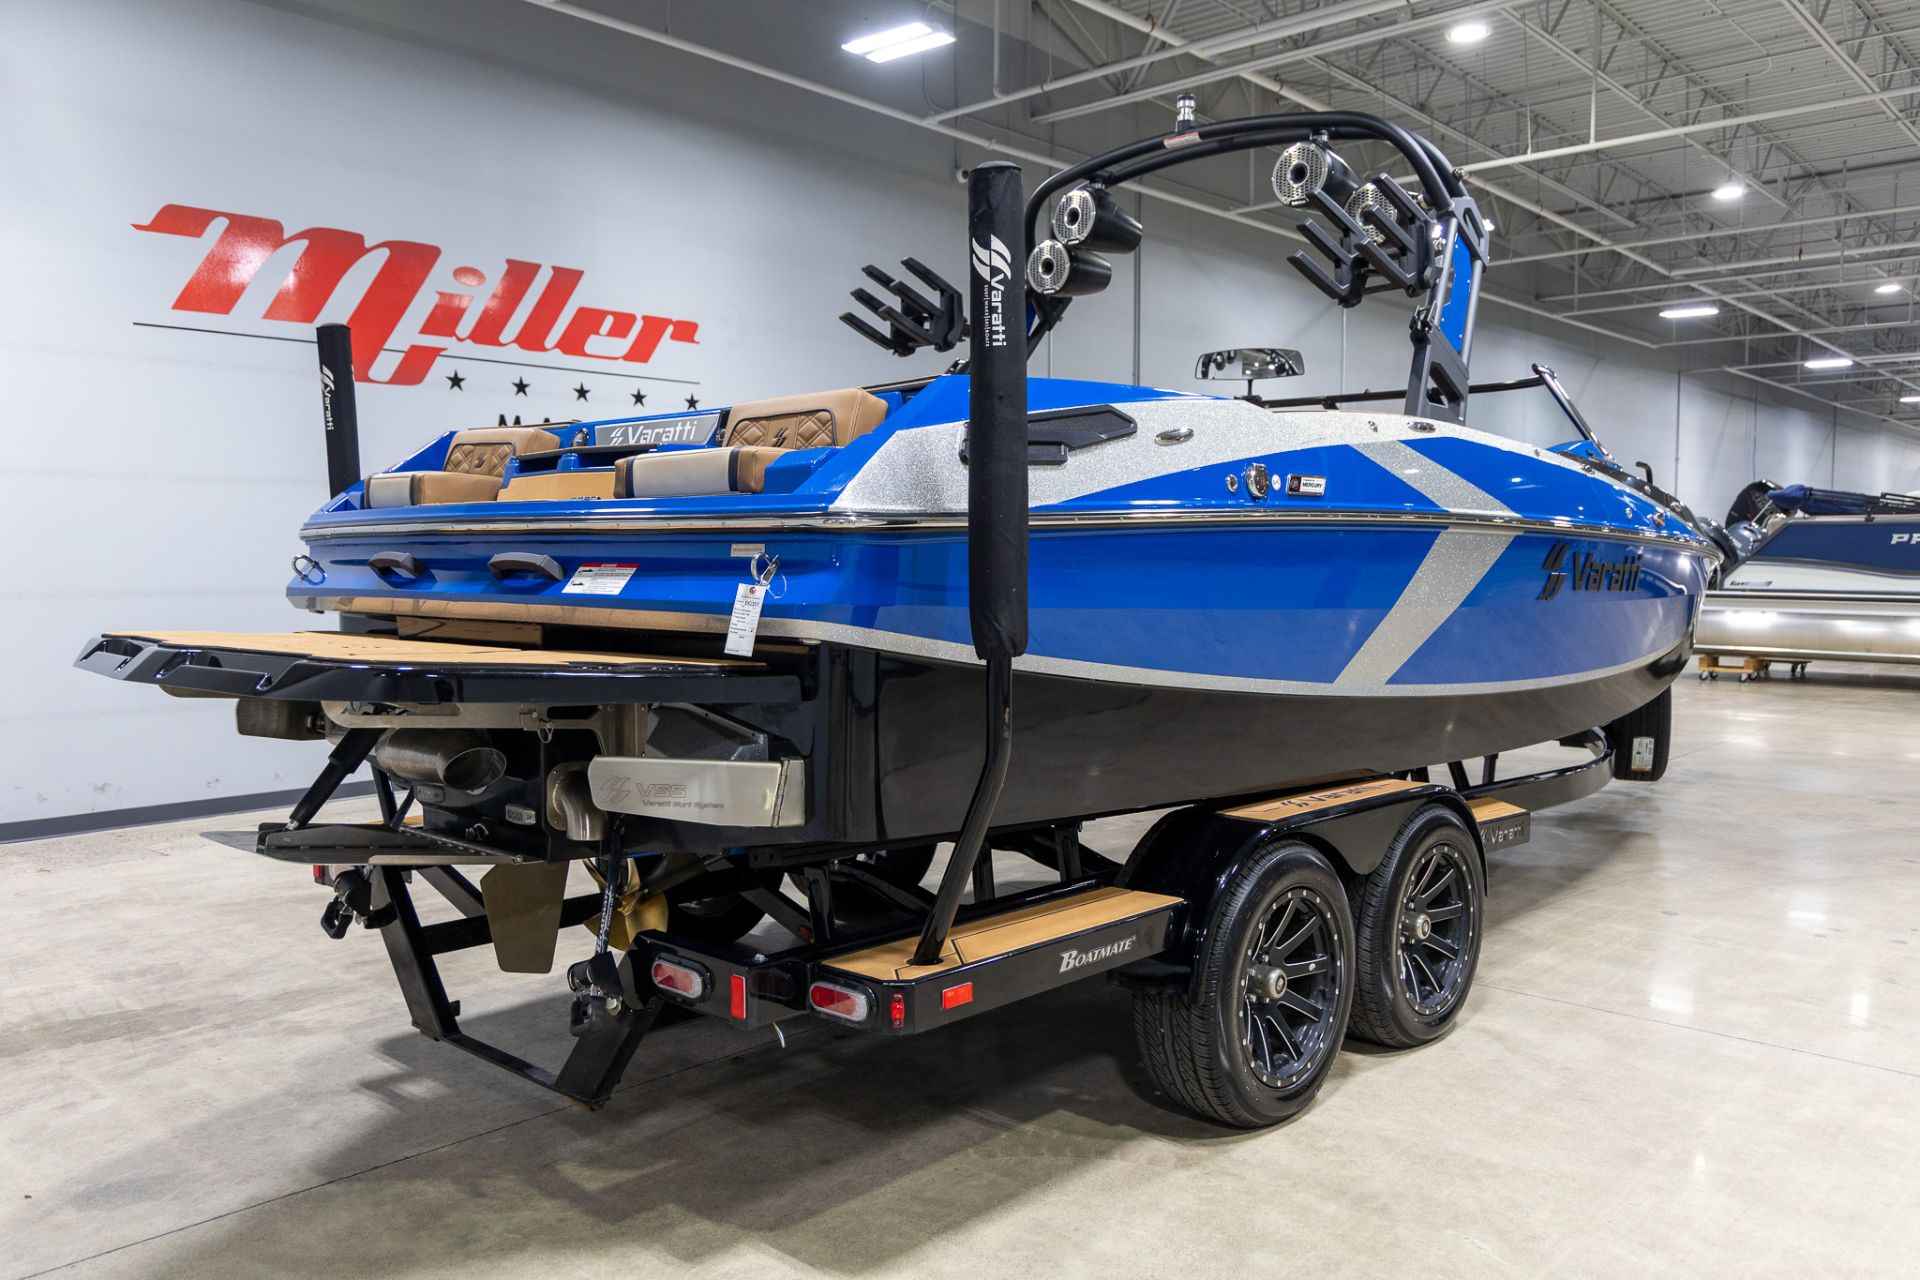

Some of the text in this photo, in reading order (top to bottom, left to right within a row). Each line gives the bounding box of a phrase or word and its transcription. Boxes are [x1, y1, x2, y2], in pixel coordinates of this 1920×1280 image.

[131, 203, 700, 386] Miller
[990, 273, 1007, 346] Varatti
[323, 386, 335, 431] Varatti
[627, 420, 698, 445] Varatti
[1572, 551, 1643, 593] Varatti
[635, 782, 687, 799] VSS
